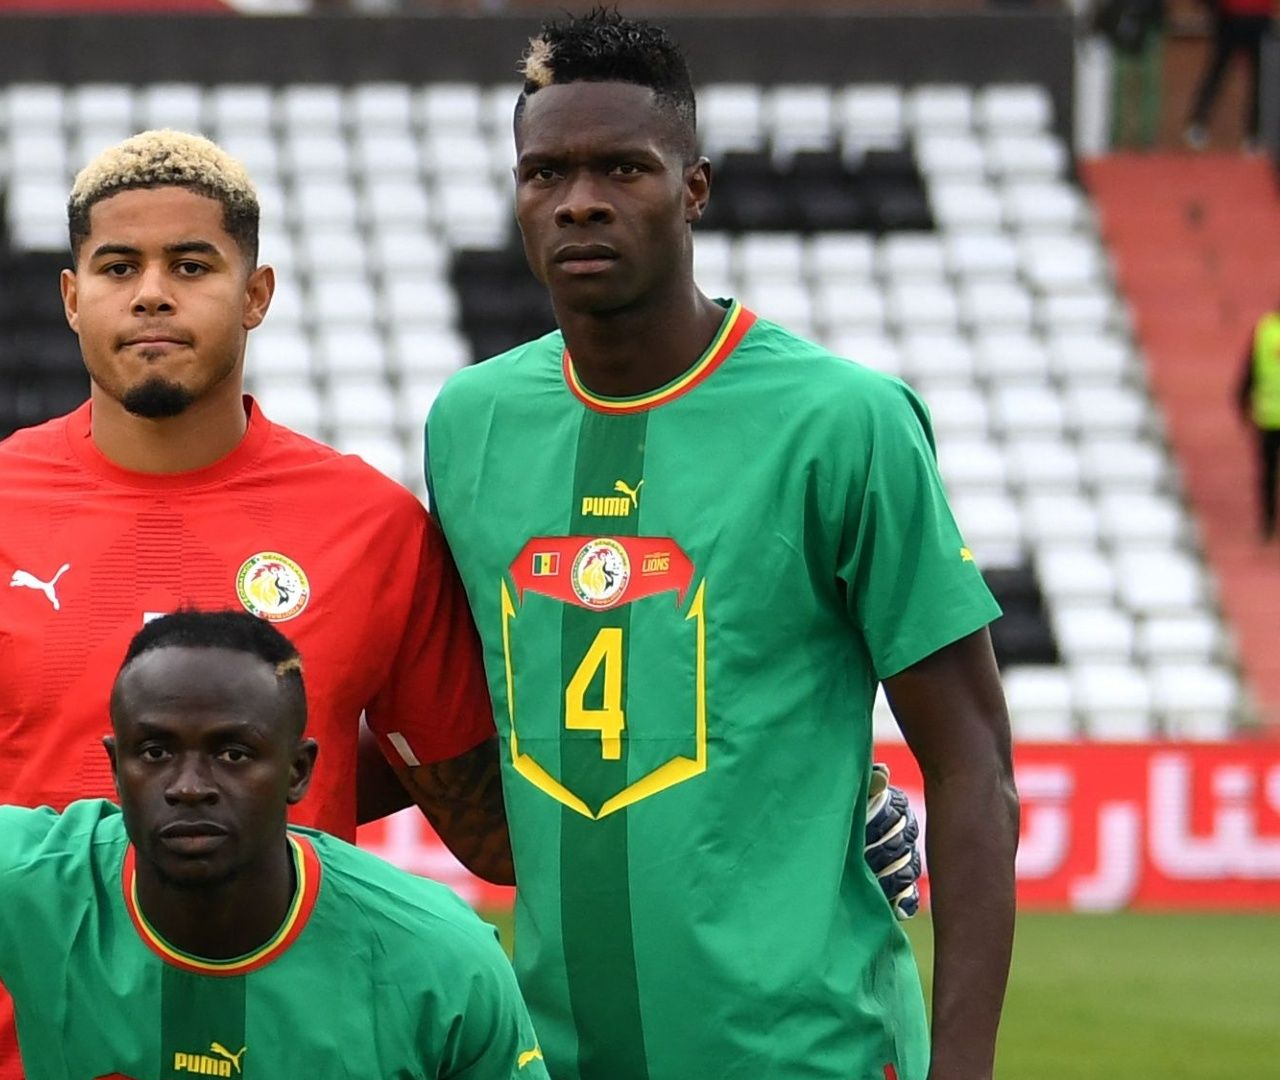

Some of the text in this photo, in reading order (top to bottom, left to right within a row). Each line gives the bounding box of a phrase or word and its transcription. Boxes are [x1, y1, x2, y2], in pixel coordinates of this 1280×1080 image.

[582, 497, 630, 516] PUMA
[642, 558, 670, 573] LIONS
[565, 628, 625, 760] 4
[174, 1053, 231, 1077] PUMA
